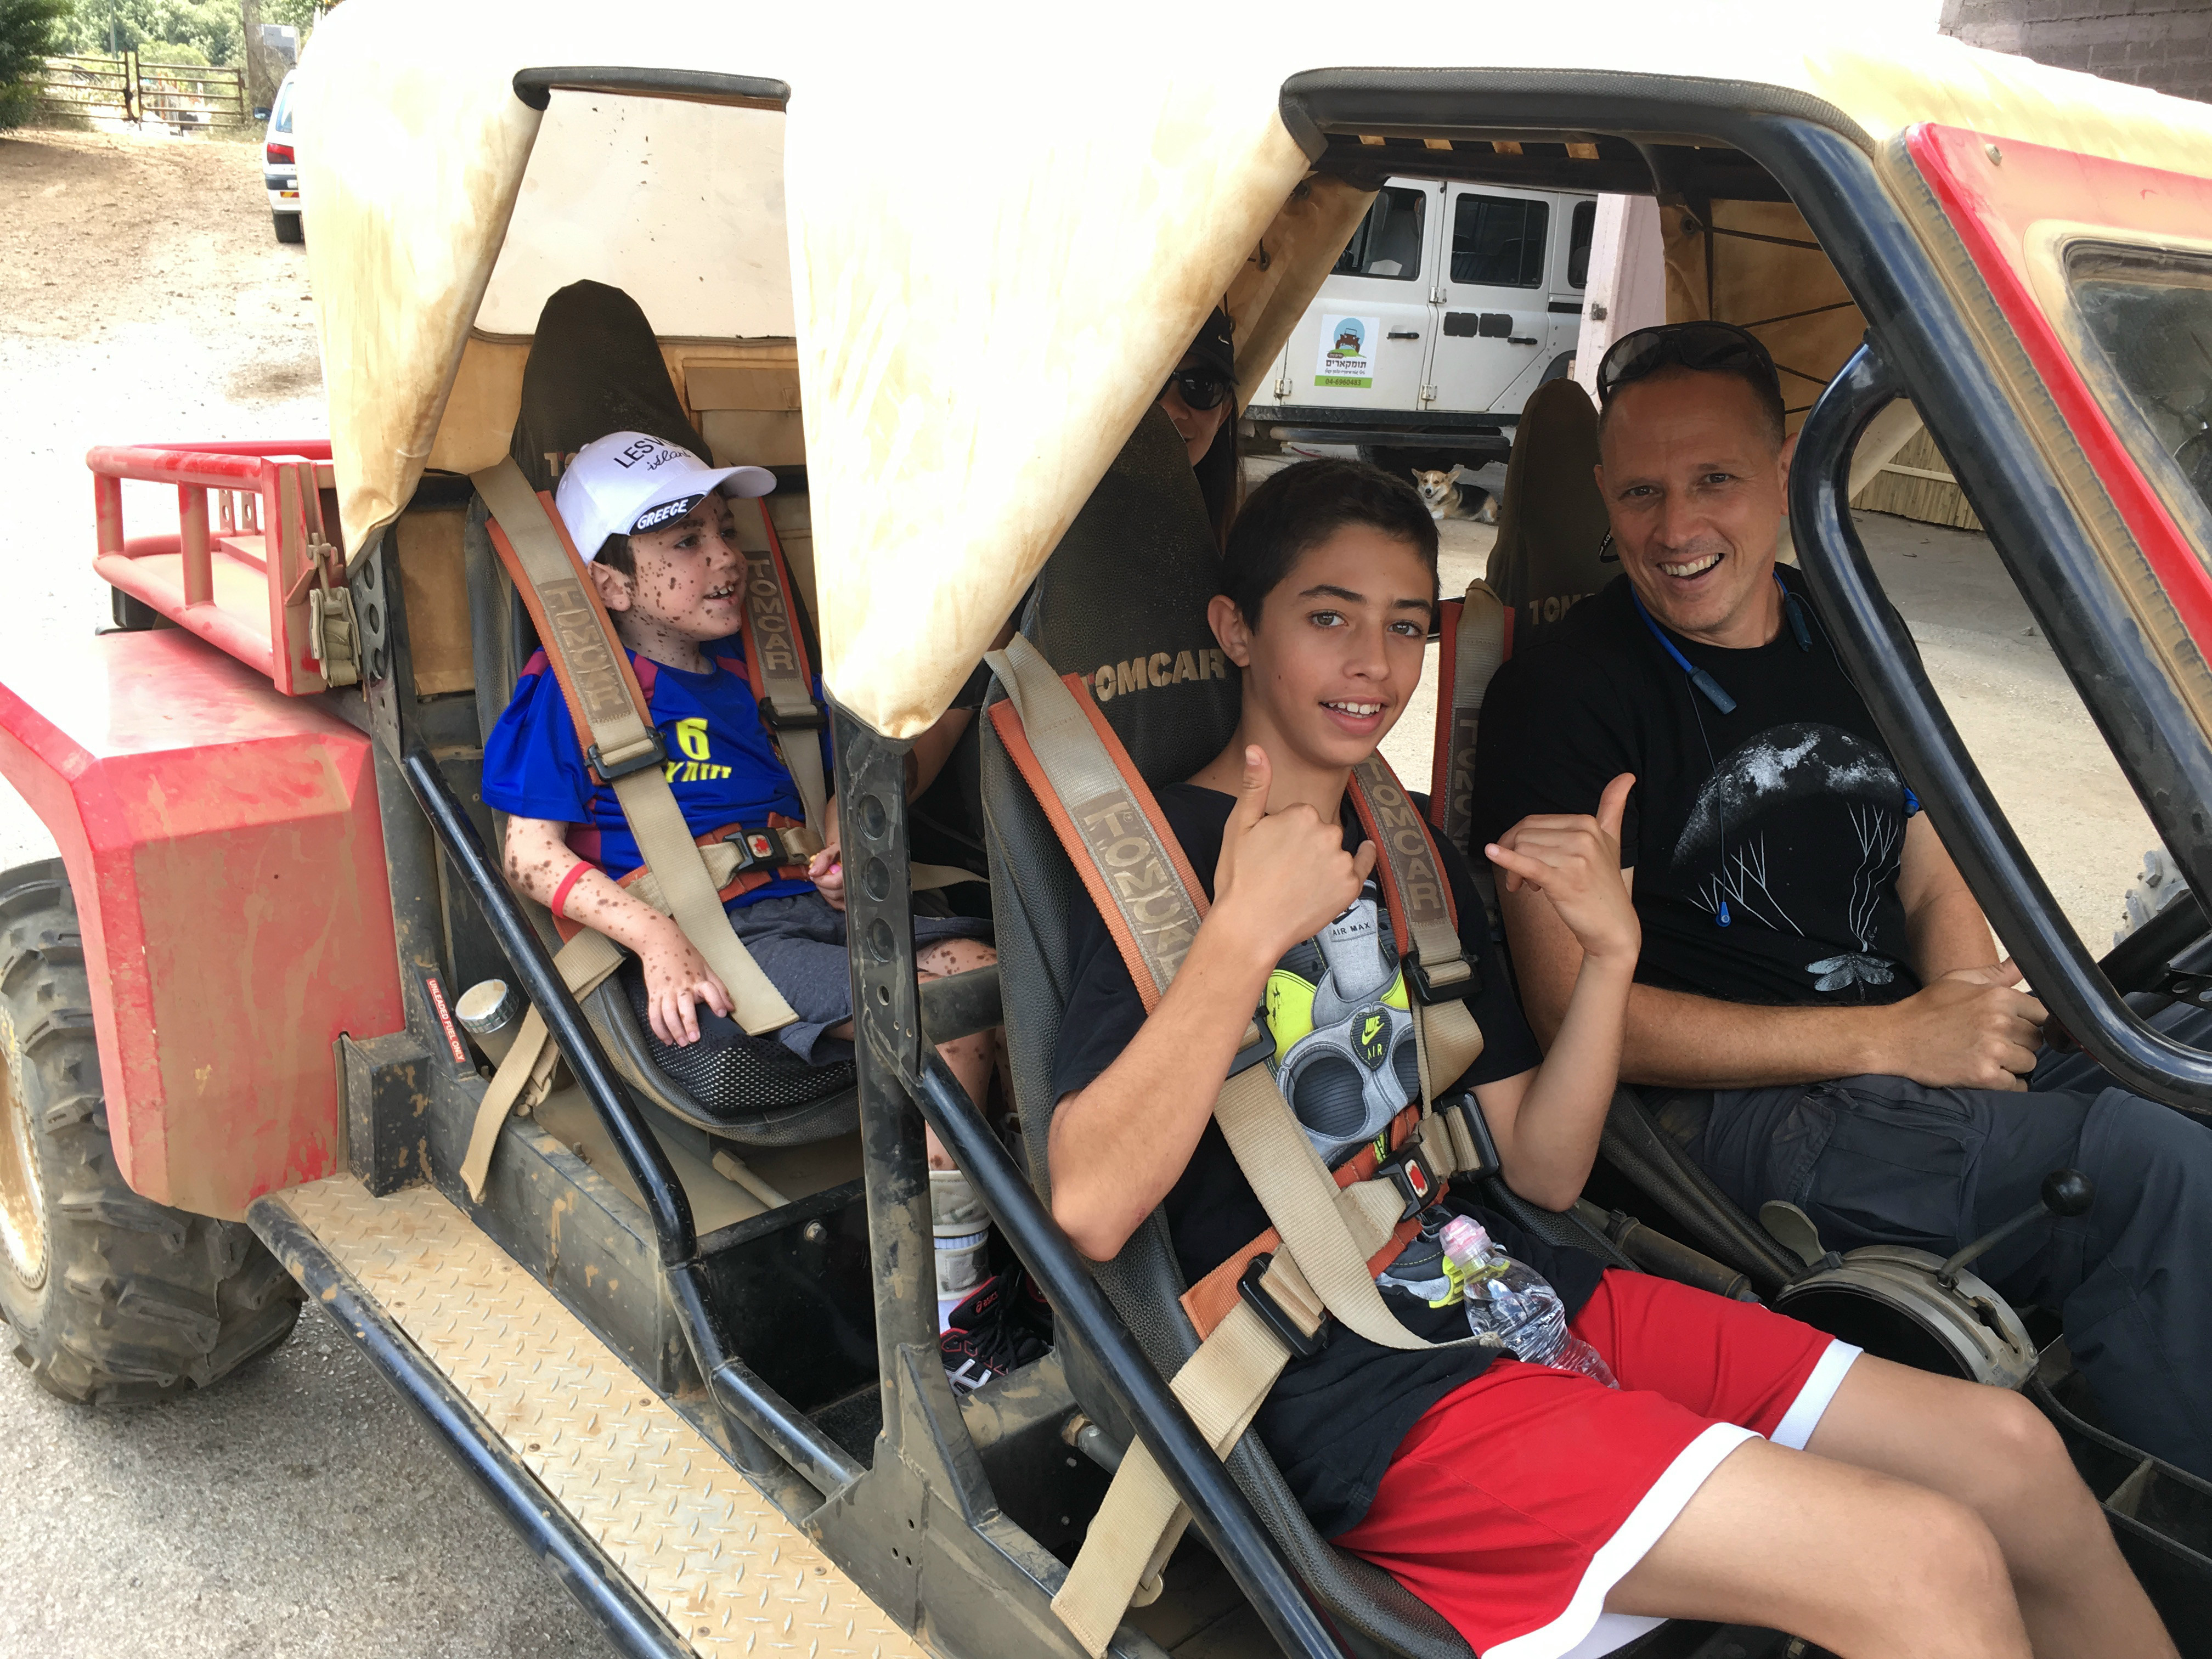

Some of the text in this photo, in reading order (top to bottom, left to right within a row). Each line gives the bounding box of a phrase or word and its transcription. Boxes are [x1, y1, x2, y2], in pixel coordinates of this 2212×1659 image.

[1325, 359, 1367, 369] תומקארים
[637, 499, 689, 530] GREECE
[747, 559, 795, 670] TOMCAR
[675, 717, 711, 761] 6
[1359, 757, 1442, 911] TOMCAR
[1333, 922, 1370, 936] AIR MAX
[429, 980, 465, 1060] UNLEADED FUEL ONLY
[1365, 1015, 1380, 1034] NIKE
